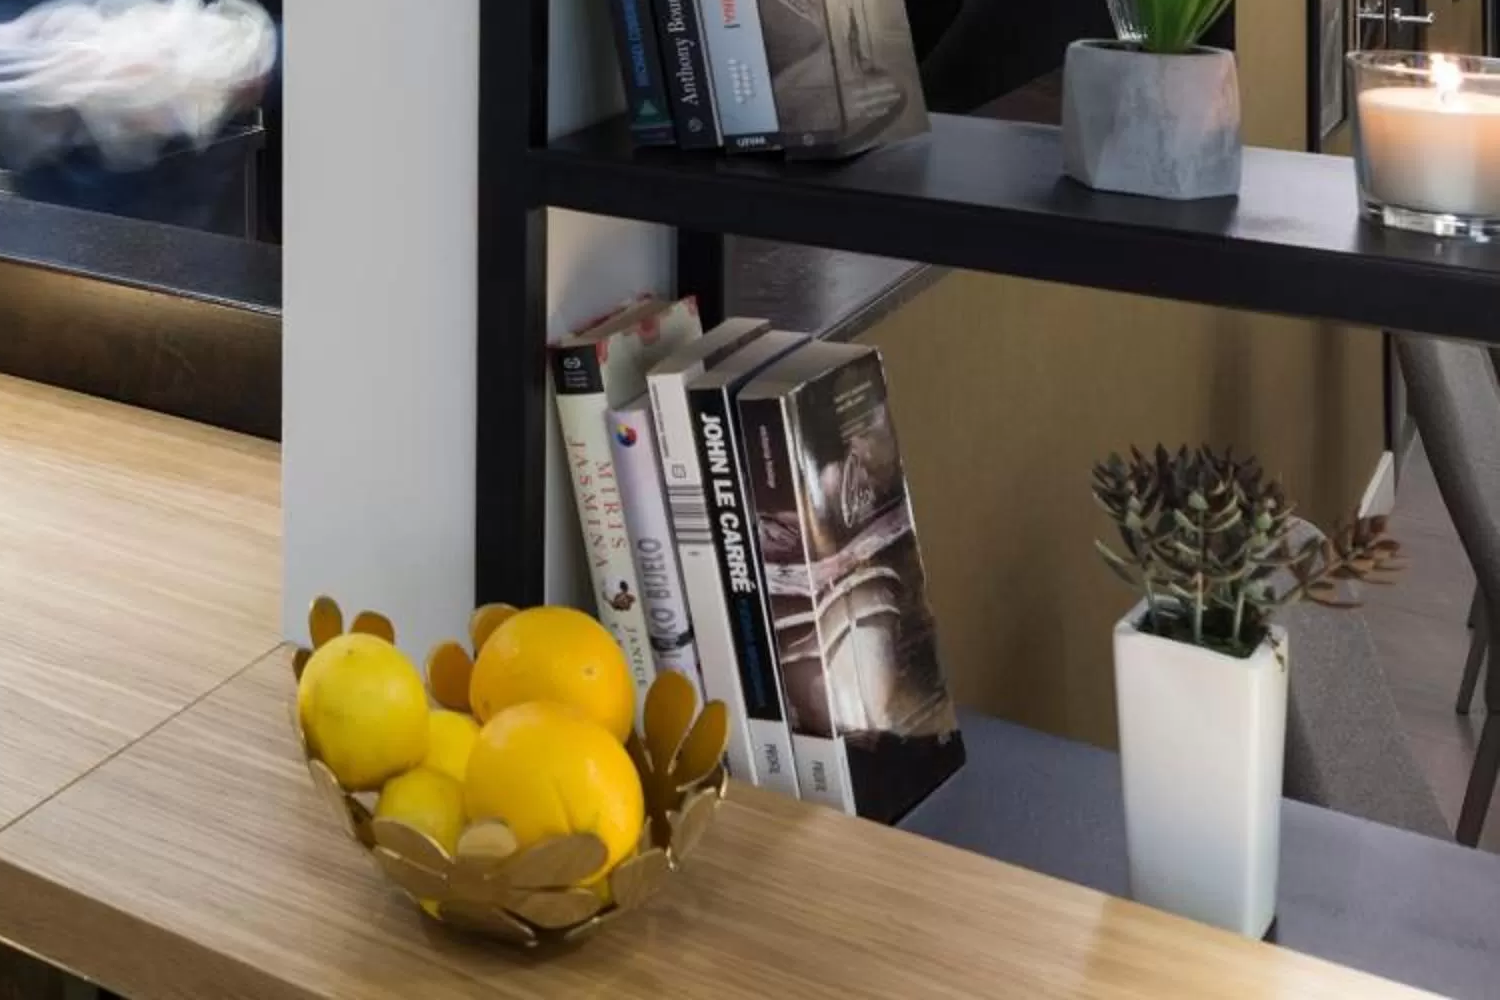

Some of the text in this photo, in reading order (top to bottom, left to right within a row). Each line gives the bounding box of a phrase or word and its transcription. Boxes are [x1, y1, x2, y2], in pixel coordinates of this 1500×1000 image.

[676, 37, 699, 106] Anthony
[701, 411, 731, 474] JOHN
[567, 436, 609, 567] JASMINA
[596, 460, 626, 549] MIRIS
[713, 479, 737, 508] LE
[637, 538, 671, 599] BIJELO
[719, 512, 757, 593] CARRÉ
